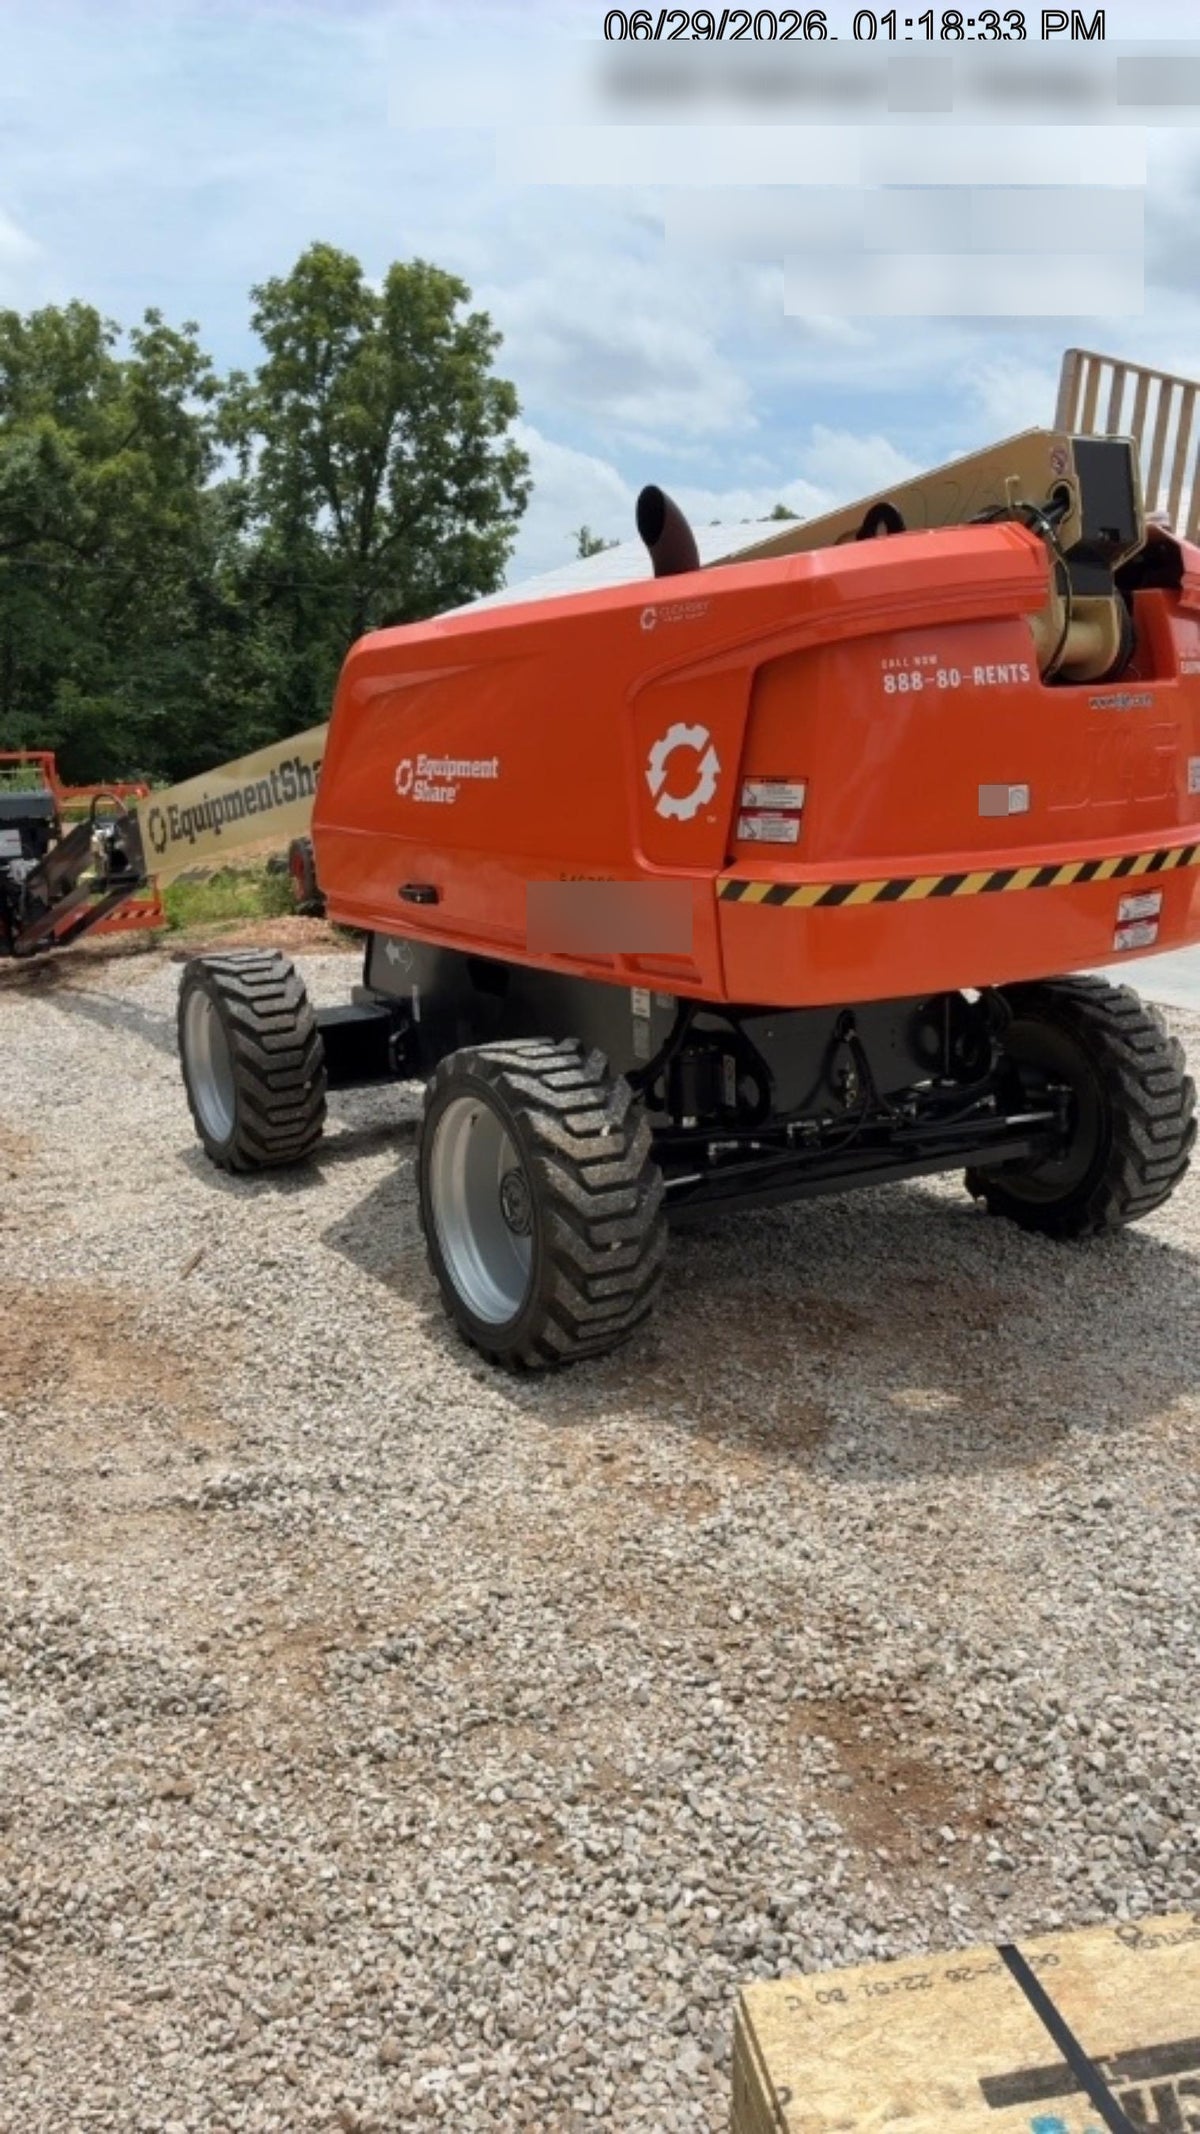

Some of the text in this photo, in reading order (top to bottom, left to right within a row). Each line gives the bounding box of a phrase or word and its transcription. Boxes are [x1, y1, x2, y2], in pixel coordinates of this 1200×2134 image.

[883, 663, 1031, 694] 888-80-RENTS
[416, 753, 499, 782] Equipment
[412, 779, 457, 804] Share
